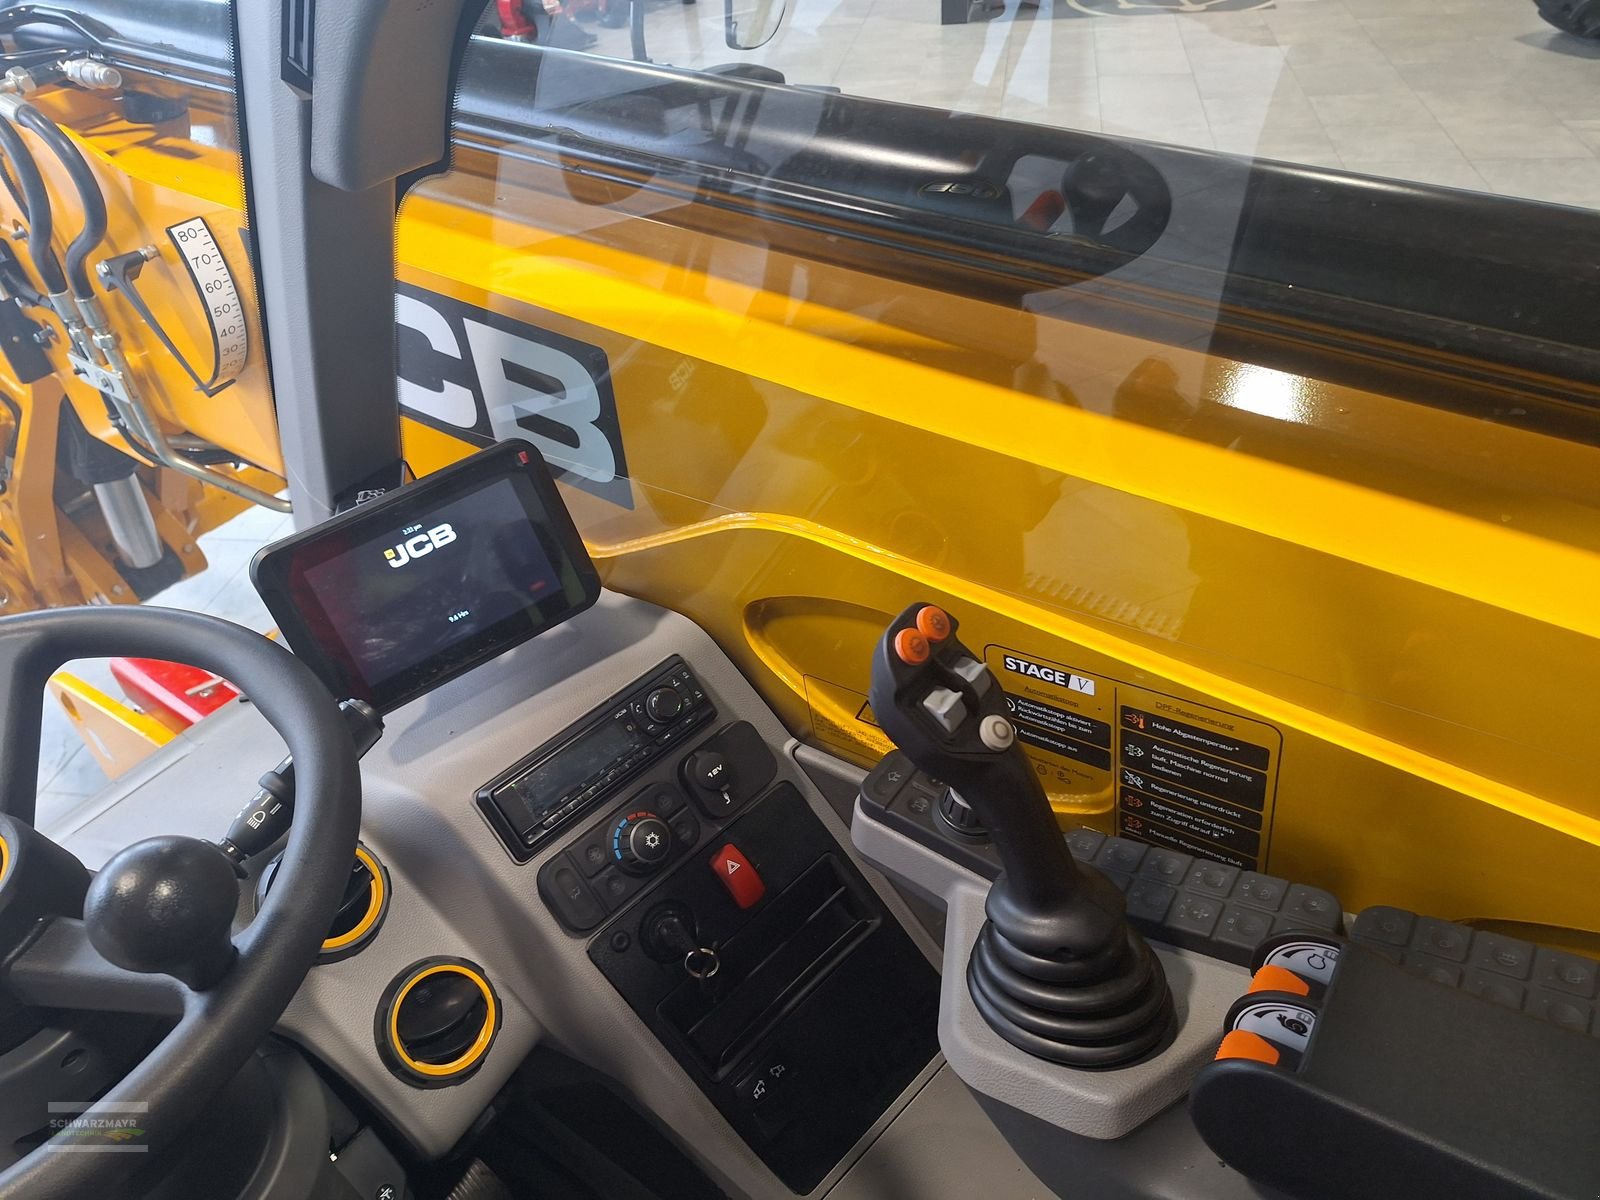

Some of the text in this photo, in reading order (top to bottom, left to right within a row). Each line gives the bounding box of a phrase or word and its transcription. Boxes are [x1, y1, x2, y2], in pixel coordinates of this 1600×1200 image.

[177, 227, 198, 243] 80
[191, 253, 212, 270] 70
[205, 279, 223, 294] 60
[214, 303, 231, 318] 50
[220, 325, 236, 338] 40
[222, 344, 239, 357] 30
[385, 523, 457, 568] JCB
[1005, 657, 1089, 690] STAGE V
[1017, 699, 1065, 719] Automatikstopp
[1155, 701, 1235, 731] DPF-Regenerierung
[1018, 713, 1066, 732] Automatikstopp
[1068, 721, 1078, 730] bis
[1078, 725, 1093, 734] zum
[1152, 721, 1172, 733] Hohe
[1067, 745, 1078, 753] aus
[707, 764, 723, 778] 12V
[1151, 763, 1182, 778] bedienen
[1152, 745, 1253, 783] Automatische Regenerierung
[1170, 759, 1202, 775] Maschine
[1202, 771, 1229, 784] normal
[1150, 783, 1199, 805] Regenerierung
[1150, 800, 1235, 835] Regeneration erforderlich
[1150, 810, 1165, 819] zum
[1188, 822, 1211, 836] darauf
[1178, 839, 1227, 863] Regenerierung
